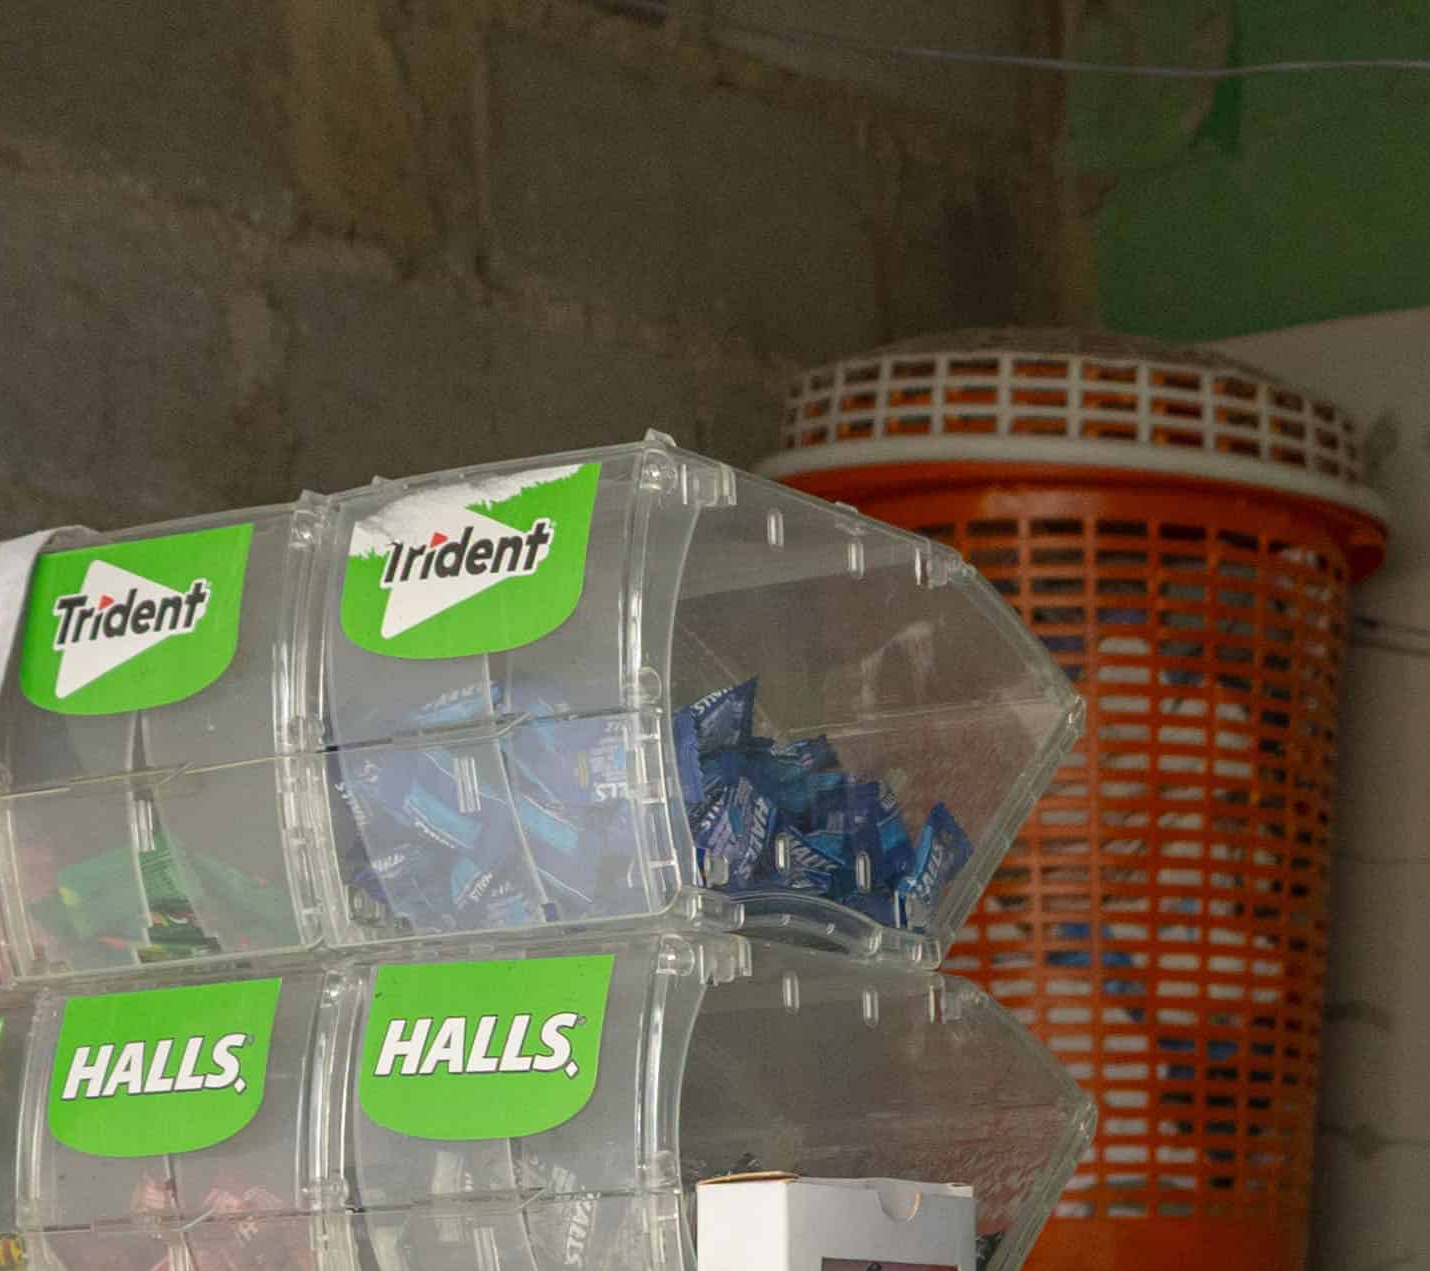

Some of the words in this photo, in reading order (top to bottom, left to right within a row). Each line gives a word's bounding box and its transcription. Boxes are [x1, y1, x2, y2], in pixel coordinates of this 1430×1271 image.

[55, 581, 208, 645] Trident
[61, 1033, 248, 1101] HALLS
[375, 1011, 578, 1078] HALLS
